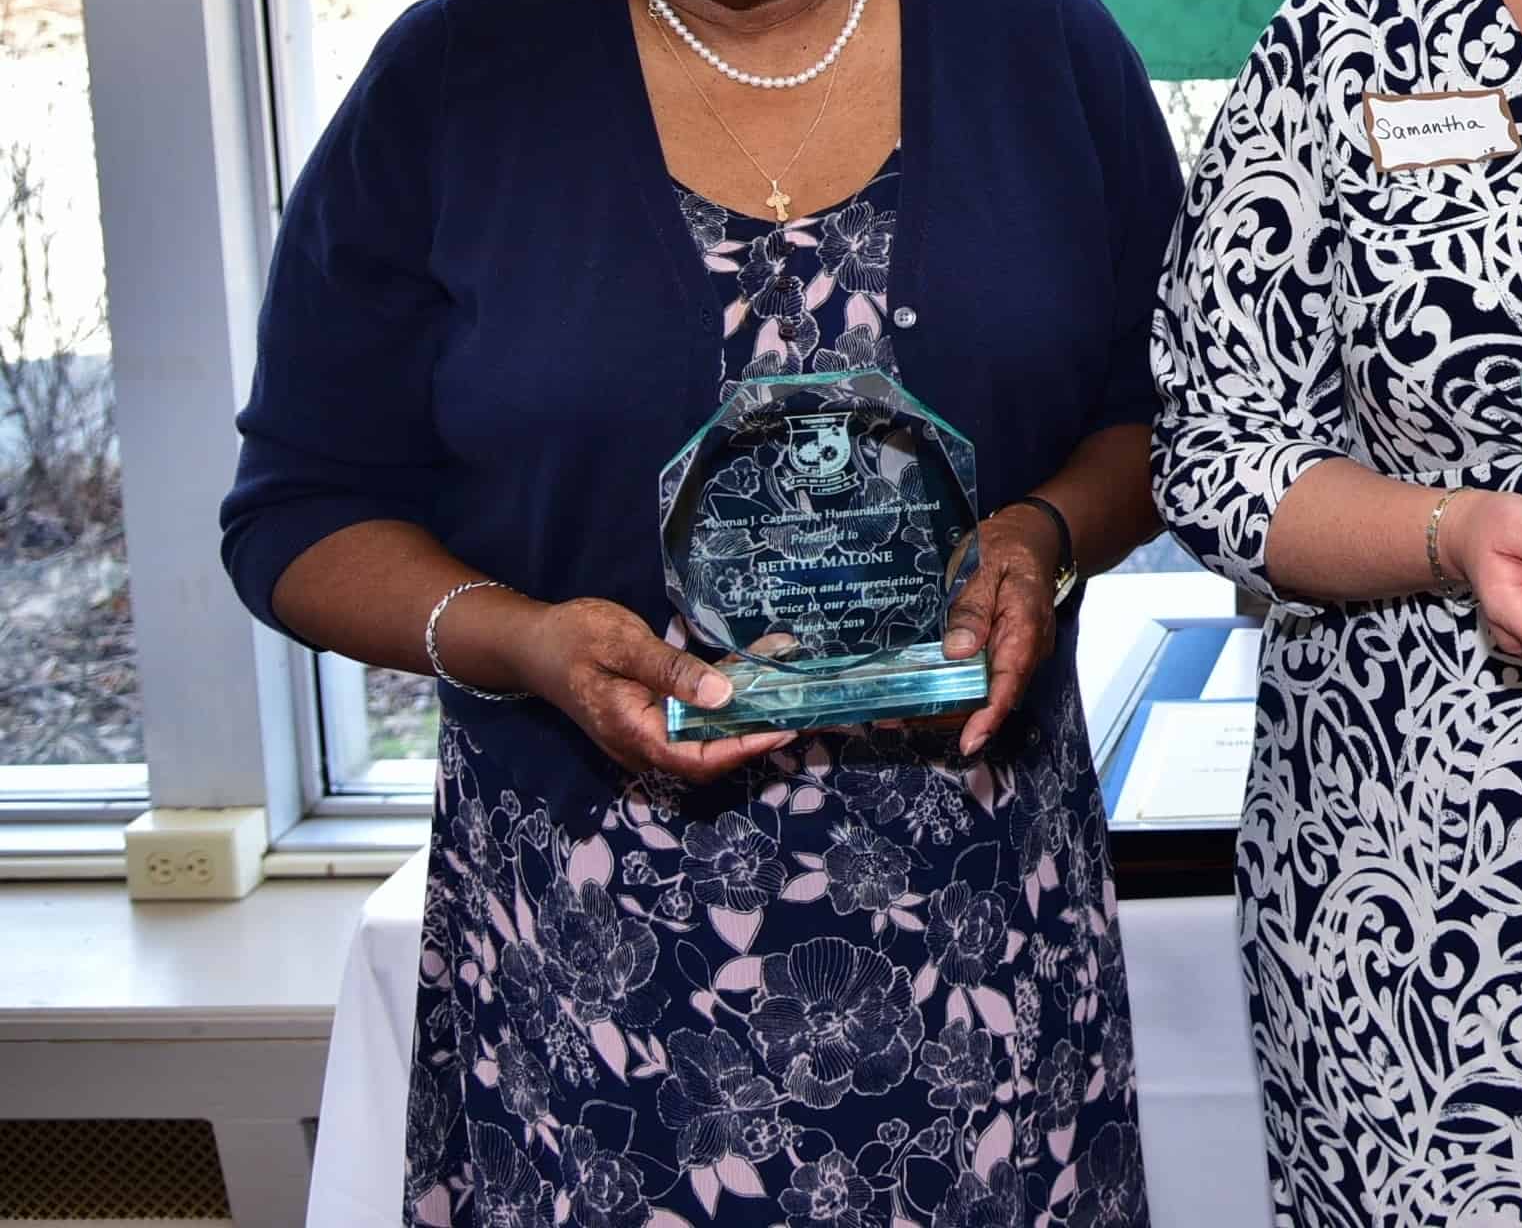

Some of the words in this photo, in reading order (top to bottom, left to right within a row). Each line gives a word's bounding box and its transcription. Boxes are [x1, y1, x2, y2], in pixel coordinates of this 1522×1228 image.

[1375, 115, 1486, 140] Samantha
[822, 550, 894, 569] MALONE
[819, 579, 844, 593] and
[845, 574, 925, 594] appreciation
[736, 606, 757, 619] For
[823, 600, 846, 612] our
